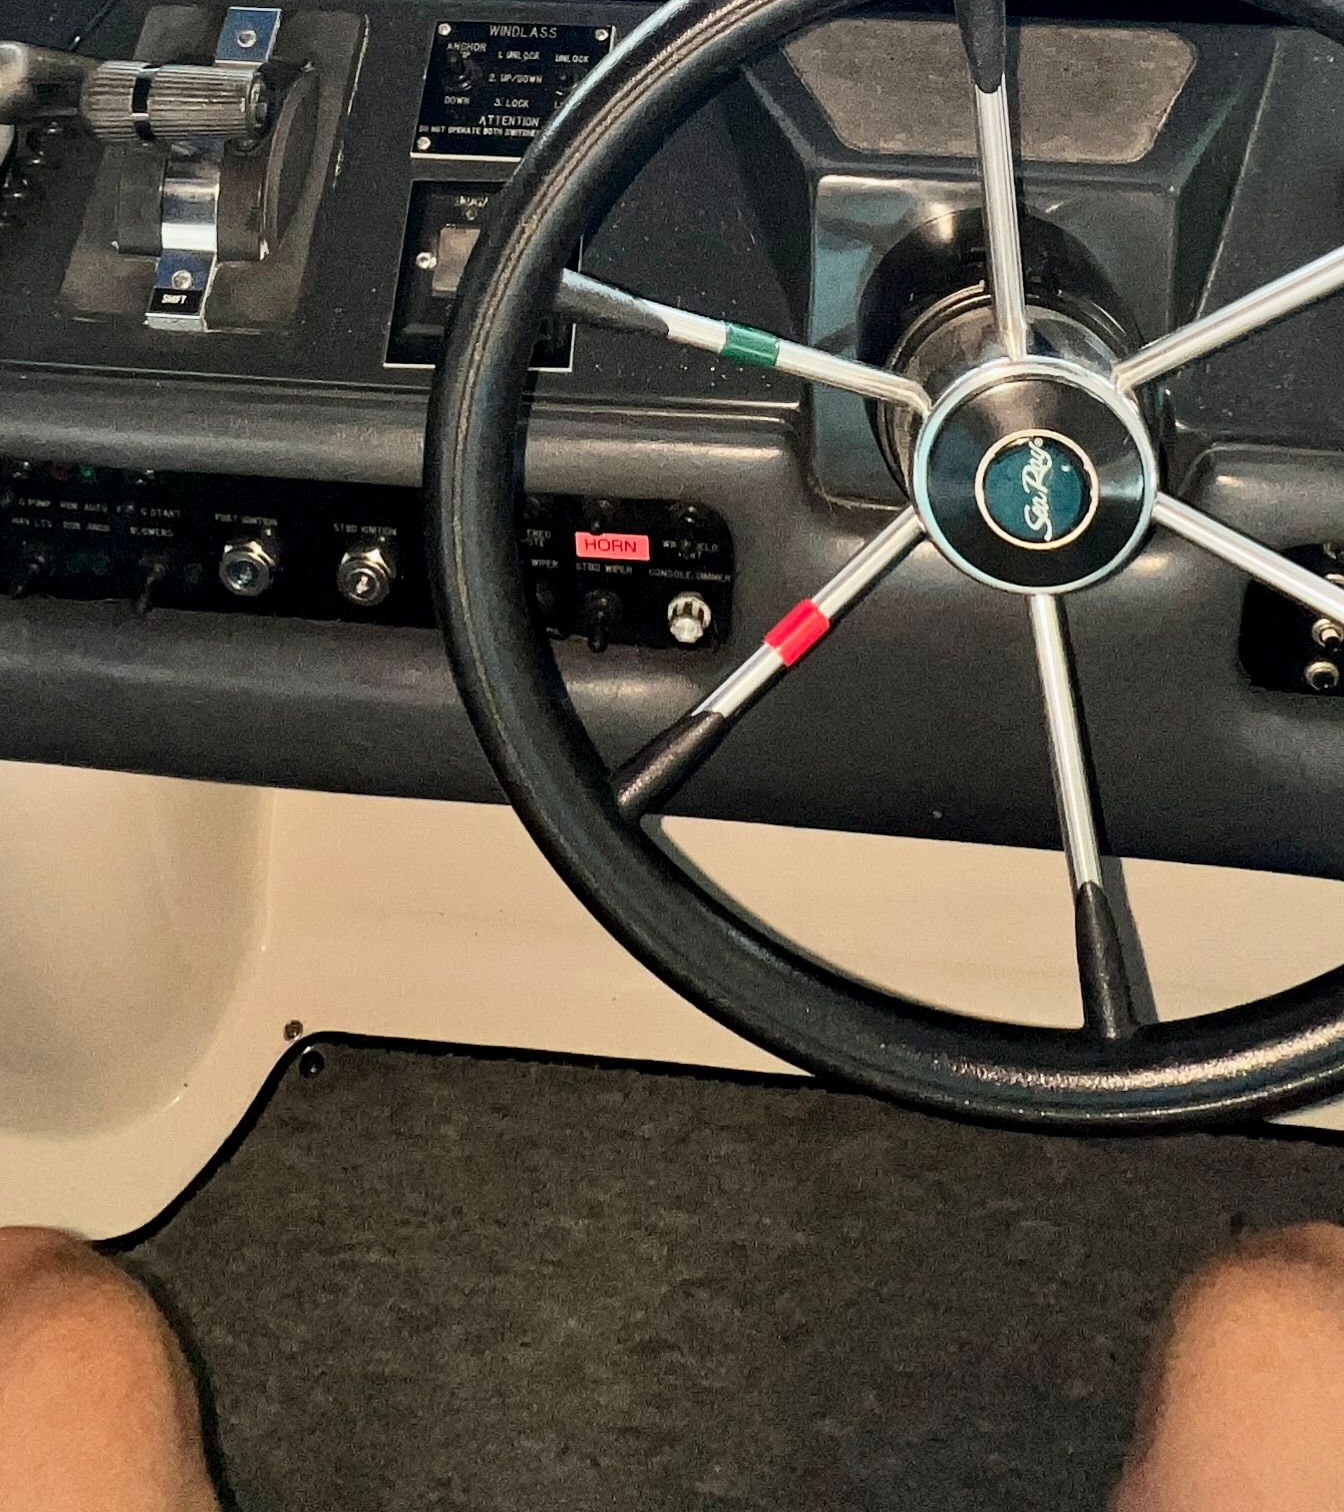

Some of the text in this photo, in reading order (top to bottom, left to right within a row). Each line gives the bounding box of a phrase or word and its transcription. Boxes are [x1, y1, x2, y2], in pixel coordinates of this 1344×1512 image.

[489, 25, 557, 39] WINDLASS
[447, 42, 487, 52] ANCHOR
[506, 51, 540, 61] UNLOCK
[555, 54, 589, 63] UNLOCK
[500, 75, 543, 84] UP/DOWN
[444, 96, 470, 105] DOWN
[506, 98, 529, 108] LOCK
[479, 115, 540, 127] ATTENTION
[448, 127, 481, 135] OPERATE
[483, 128, 502, 136] BOTH
[361, 525, 397, 536] IGNITION
[584, 538, 637, 553] HORN
[531, 558, 558, 569] WIPER
[648, 569, 690, 579] CONSOLE
